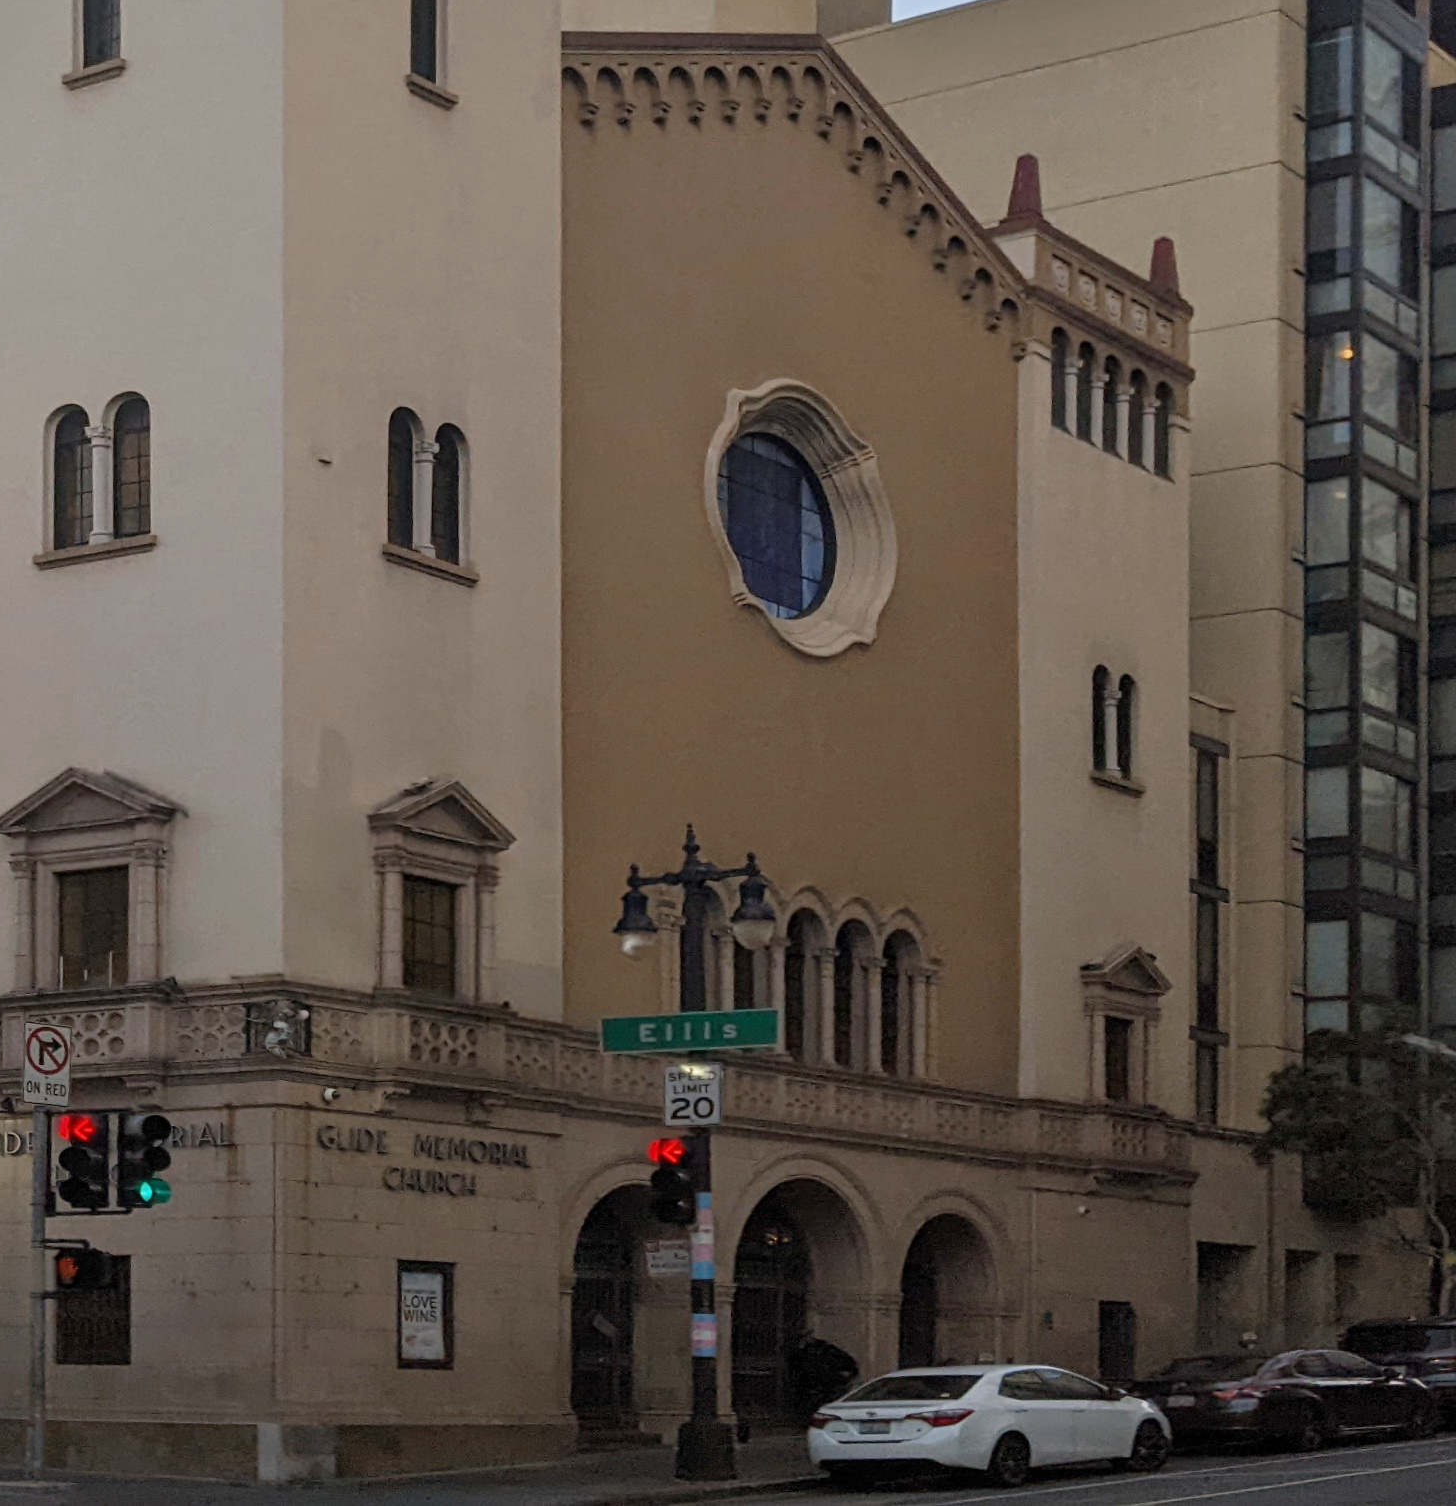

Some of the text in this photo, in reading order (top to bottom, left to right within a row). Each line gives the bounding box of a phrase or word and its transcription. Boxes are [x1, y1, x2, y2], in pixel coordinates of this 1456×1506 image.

[639, 1021, 738, 1043] Ellis
[26, 1080, 67, 1097] ON RED
[673, 1084, 710, 1095] LIMIT
[670, 1097, 715, 1120] 20
[169, 1121, 232, 1148] RIAL
[317, 1125, 532, 1169] GLIDE MEMORIAL
[382, 1167, 477, 1197] CHURCH
[403, 1295, 438, 1309] LOVE
[403, 1309, 438, 1323] WINS
